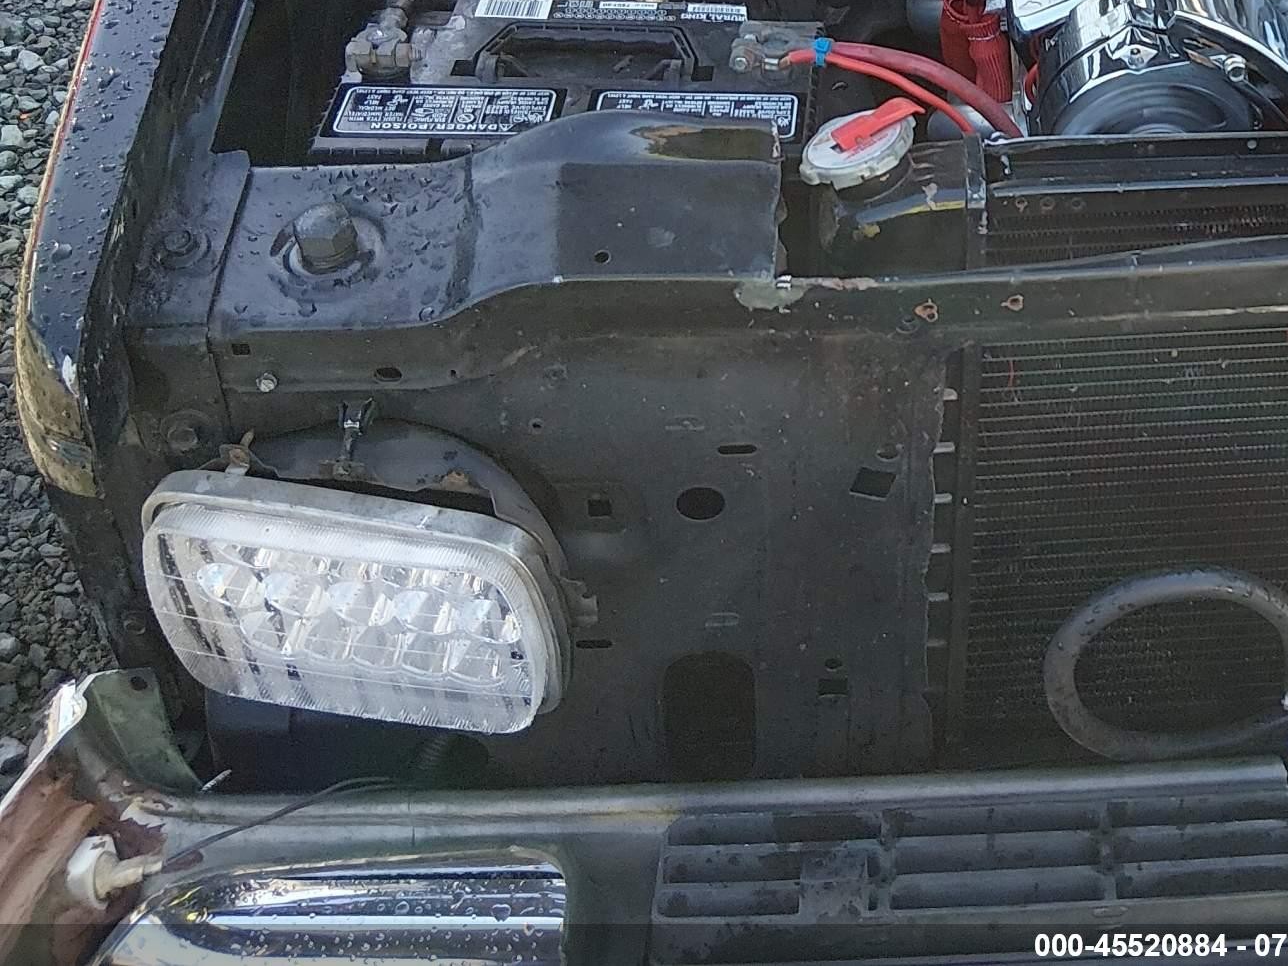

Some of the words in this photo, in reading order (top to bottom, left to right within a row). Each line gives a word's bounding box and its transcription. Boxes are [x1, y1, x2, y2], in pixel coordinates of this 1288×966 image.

[680, 12, 708, 21] KING
[708, 13, 746, 22] RURAL
[370, 122, 498, 132] DANGER/POISON
